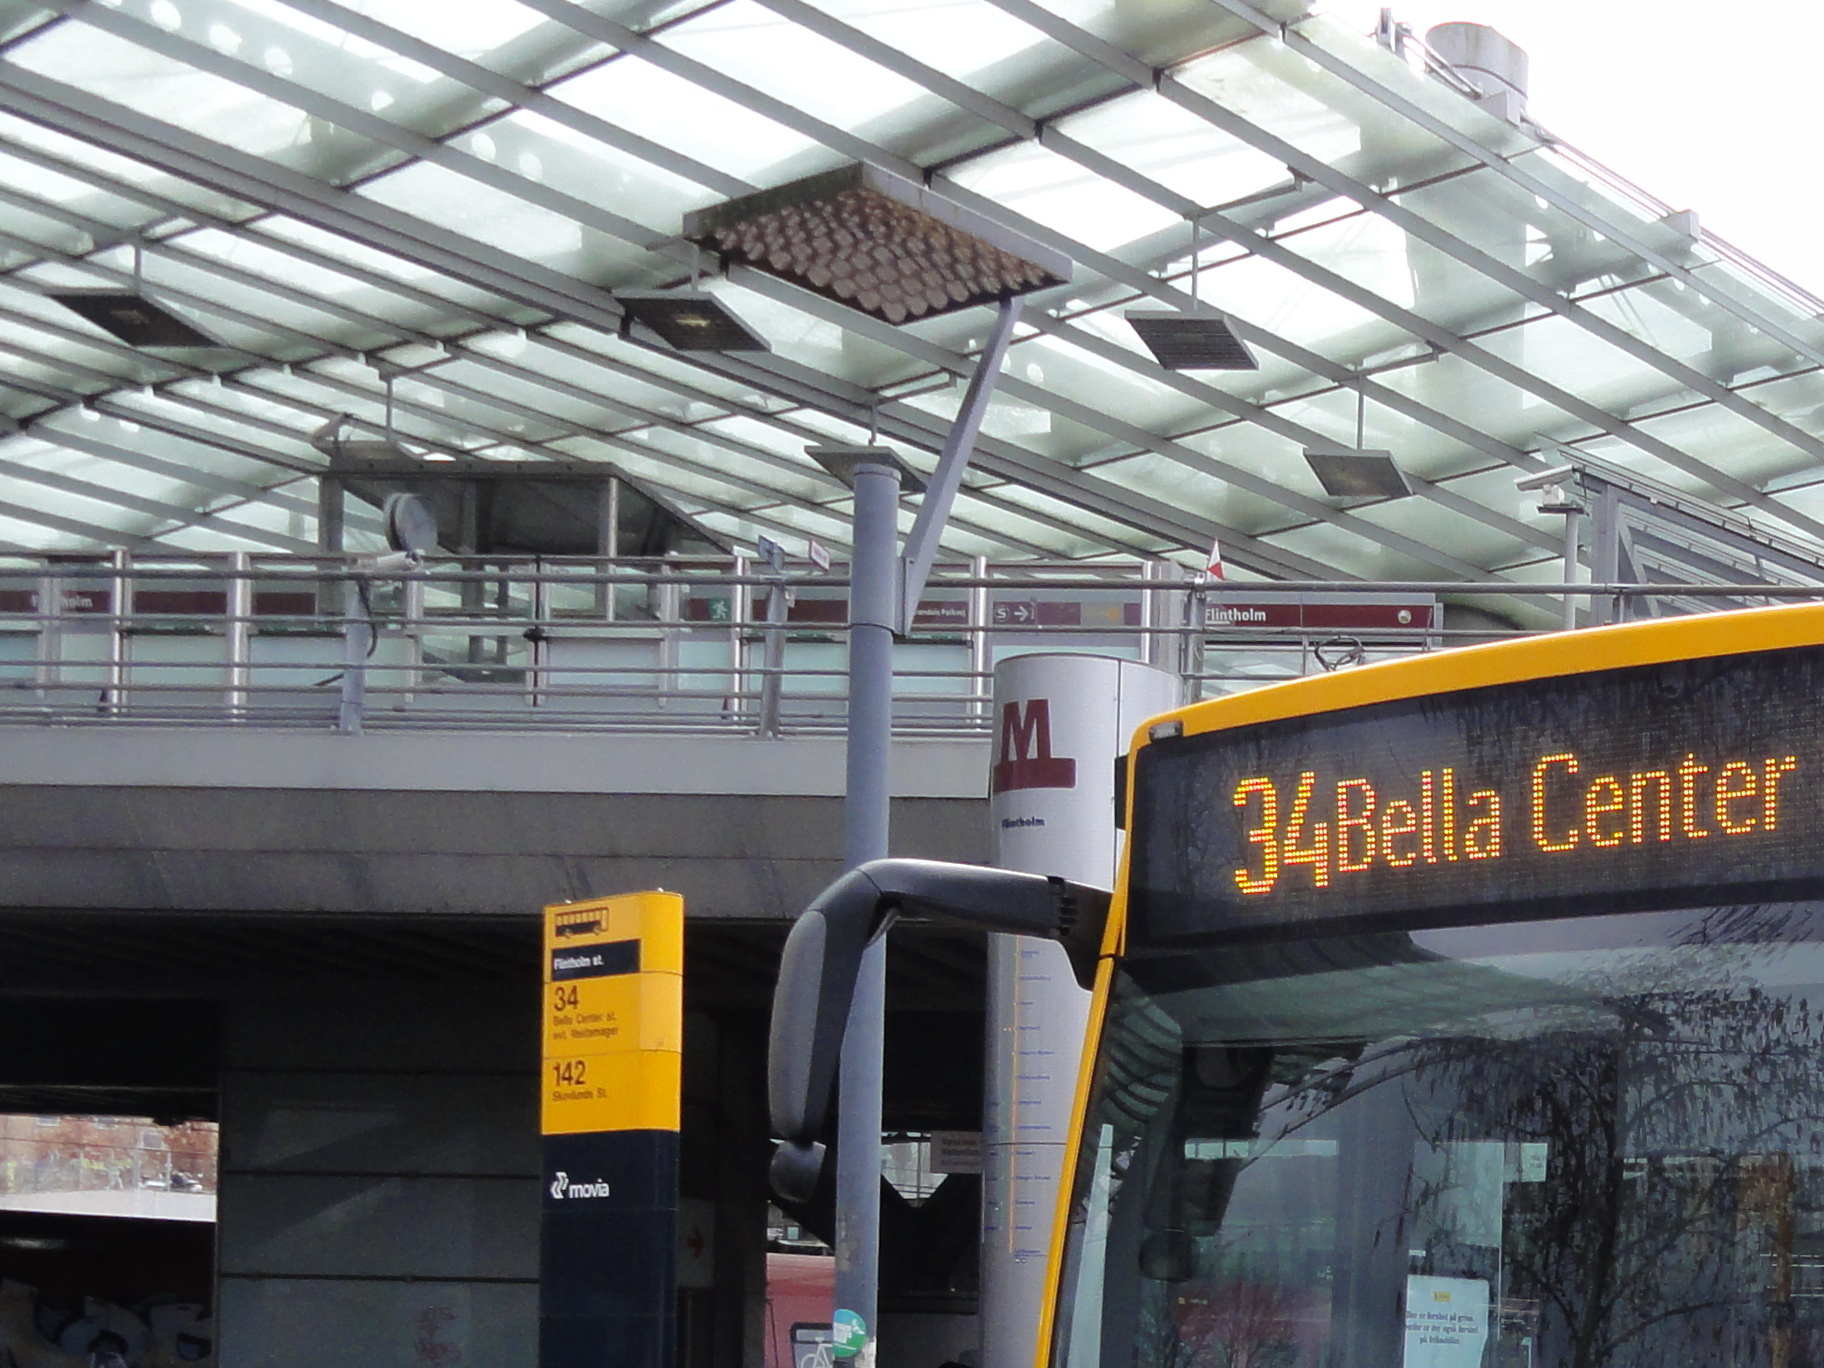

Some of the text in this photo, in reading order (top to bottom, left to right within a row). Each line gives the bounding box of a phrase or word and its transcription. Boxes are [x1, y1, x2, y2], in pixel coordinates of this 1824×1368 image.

[1204, 607, 1267, 622] Flintholm
[1233, 771, 1330, 894] 34
[1336, 768, 1501, 873] Bella
[1531, 751, 1797, 852] Center
[553, 984, 579, 1012] 34
[552, 1059, 586, 1087] 142
[568, 1178, 610, 1199] movia
